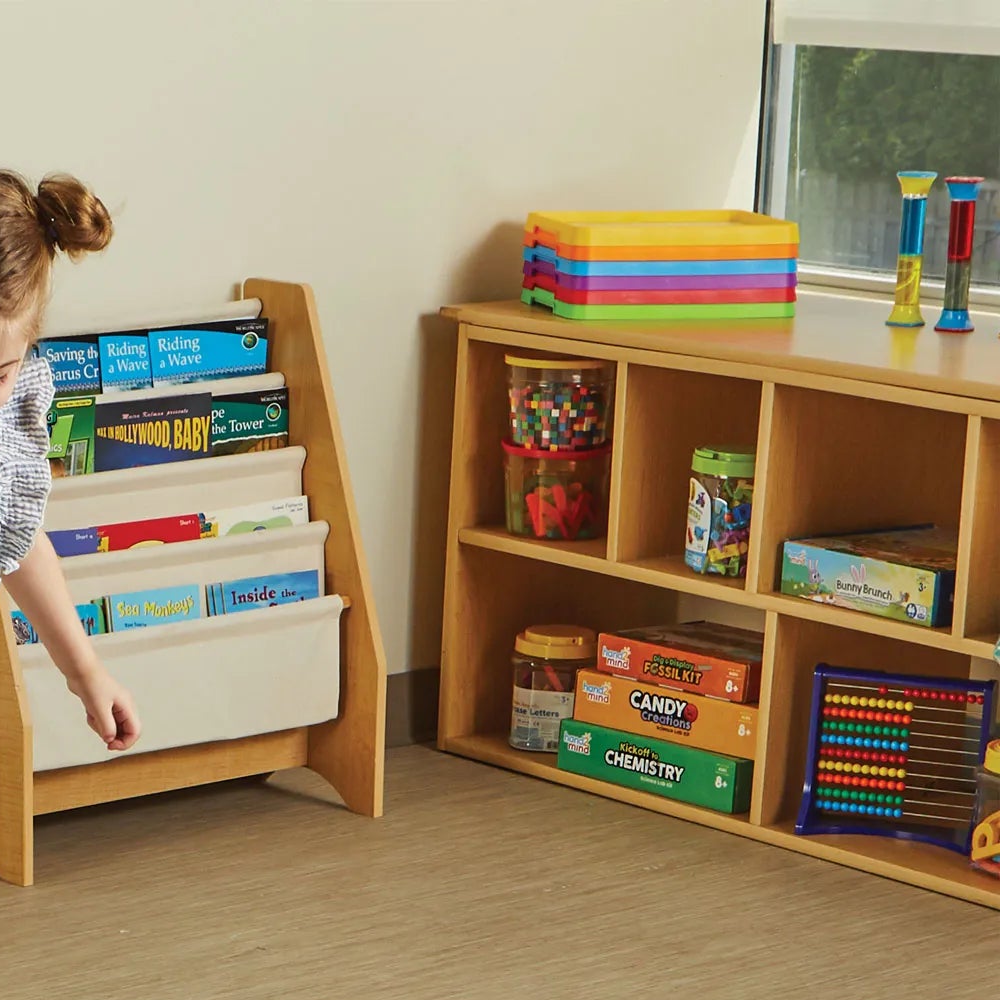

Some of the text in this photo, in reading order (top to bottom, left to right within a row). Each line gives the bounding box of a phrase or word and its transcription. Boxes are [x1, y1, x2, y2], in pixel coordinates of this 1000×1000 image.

[107, 341, 147, 358] Riding
[158, 336, 200, 353] Riding
[46, 346, 85, 364] Saving
[159, 353, 202, 368] a Wave
[83, 364, 99, 379] Cr
[108, 358, 149, 373] a Wave
[211, 408, 226, 423] pe
[115, 420, 172, 451] HOLLYWOOD,
[174, 415, 211, 452] BABY
[211, 419, 265, 435] the Tower
[231, 586, 277, 605] Inside
[281, 588, 297, 598] the
[836, 579, 863, 596] Bunny
[863, 584, 893, 601] Brunch
[117, 601, 140, 618] Sea
[607, 658, 629, 669] mind
[653, 655, 664, 665] Dig
[643, 661, 702, 684] FOSSIL KIT
[587, 693, 609, 703] mind
[630, 691, 687, 717] CANDY
[514, 707, 528, 716] ase
[529, 707, 560, 718] Letters
[568, 743, 590, 754] mind
[619, 743, 659, 760] Kickoff to
[604, 749, 684, 782] CHEMISTRY
[714, 775, 728, 789] 8+
